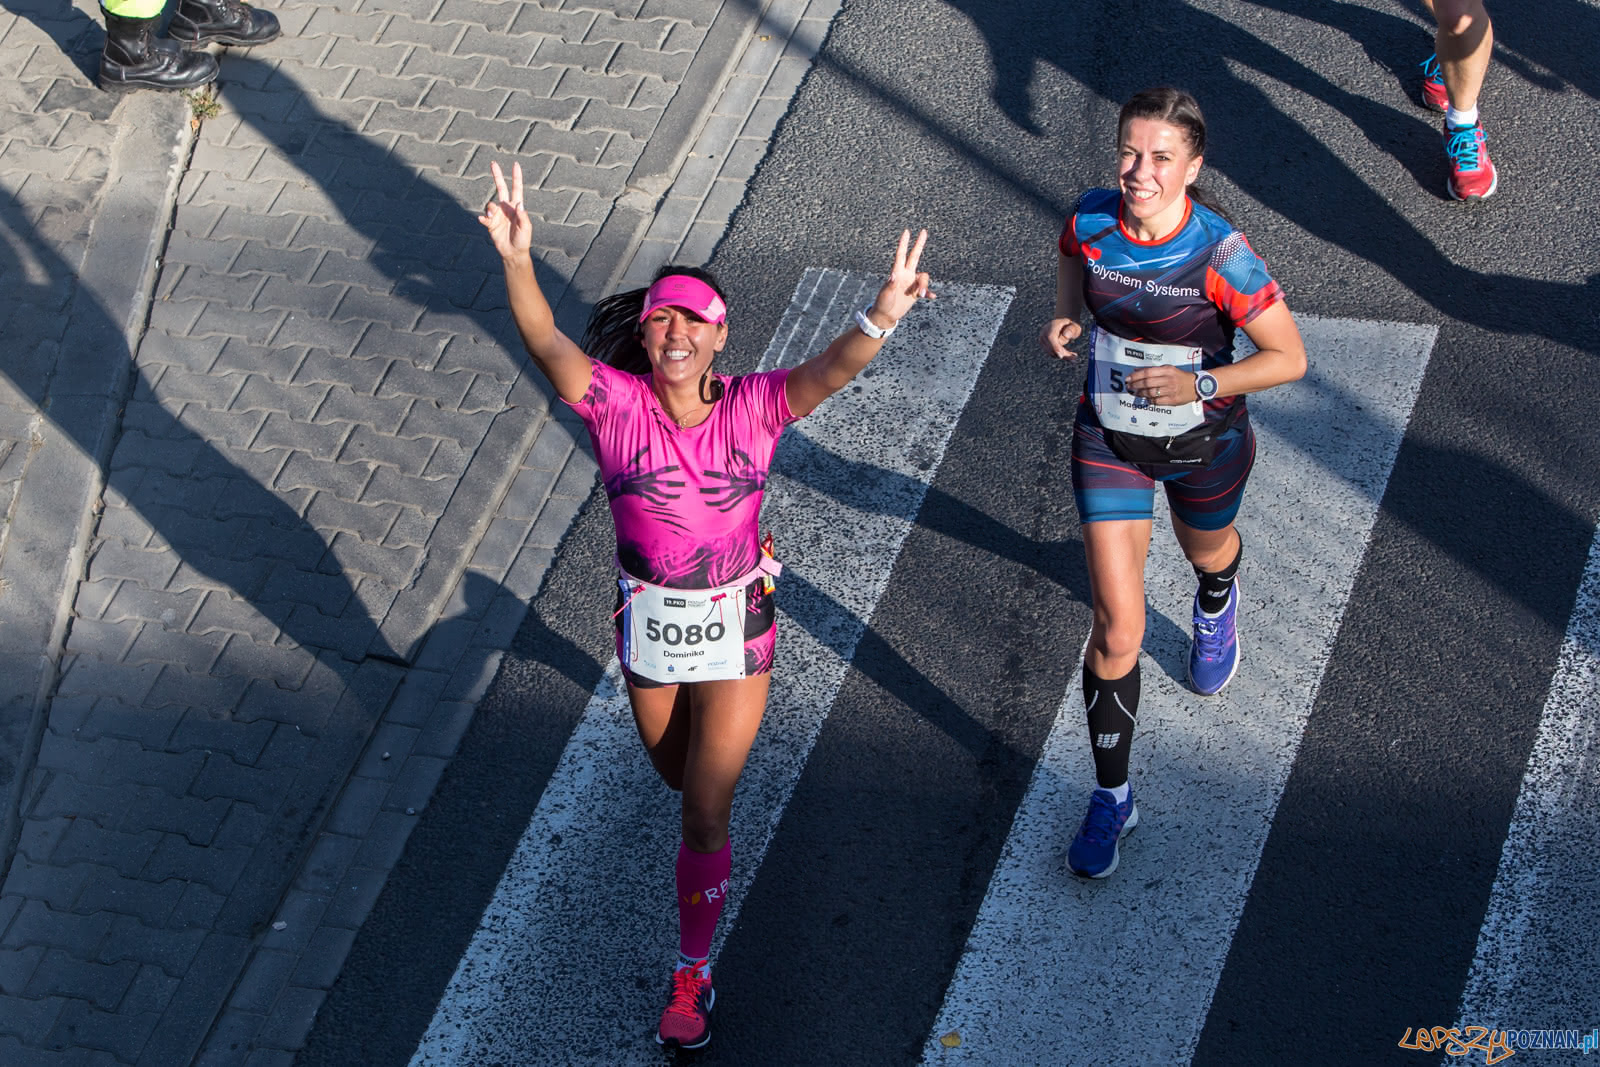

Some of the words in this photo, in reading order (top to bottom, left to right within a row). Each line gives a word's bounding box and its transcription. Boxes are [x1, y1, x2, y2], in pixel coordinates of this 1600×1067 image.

[1087, 257, 1142, 290] Polychem
[1145, 279, 1201, 297] Systems
[646, 616, 725, 646] 5080
[663, 649, 705, 659] Dominika
